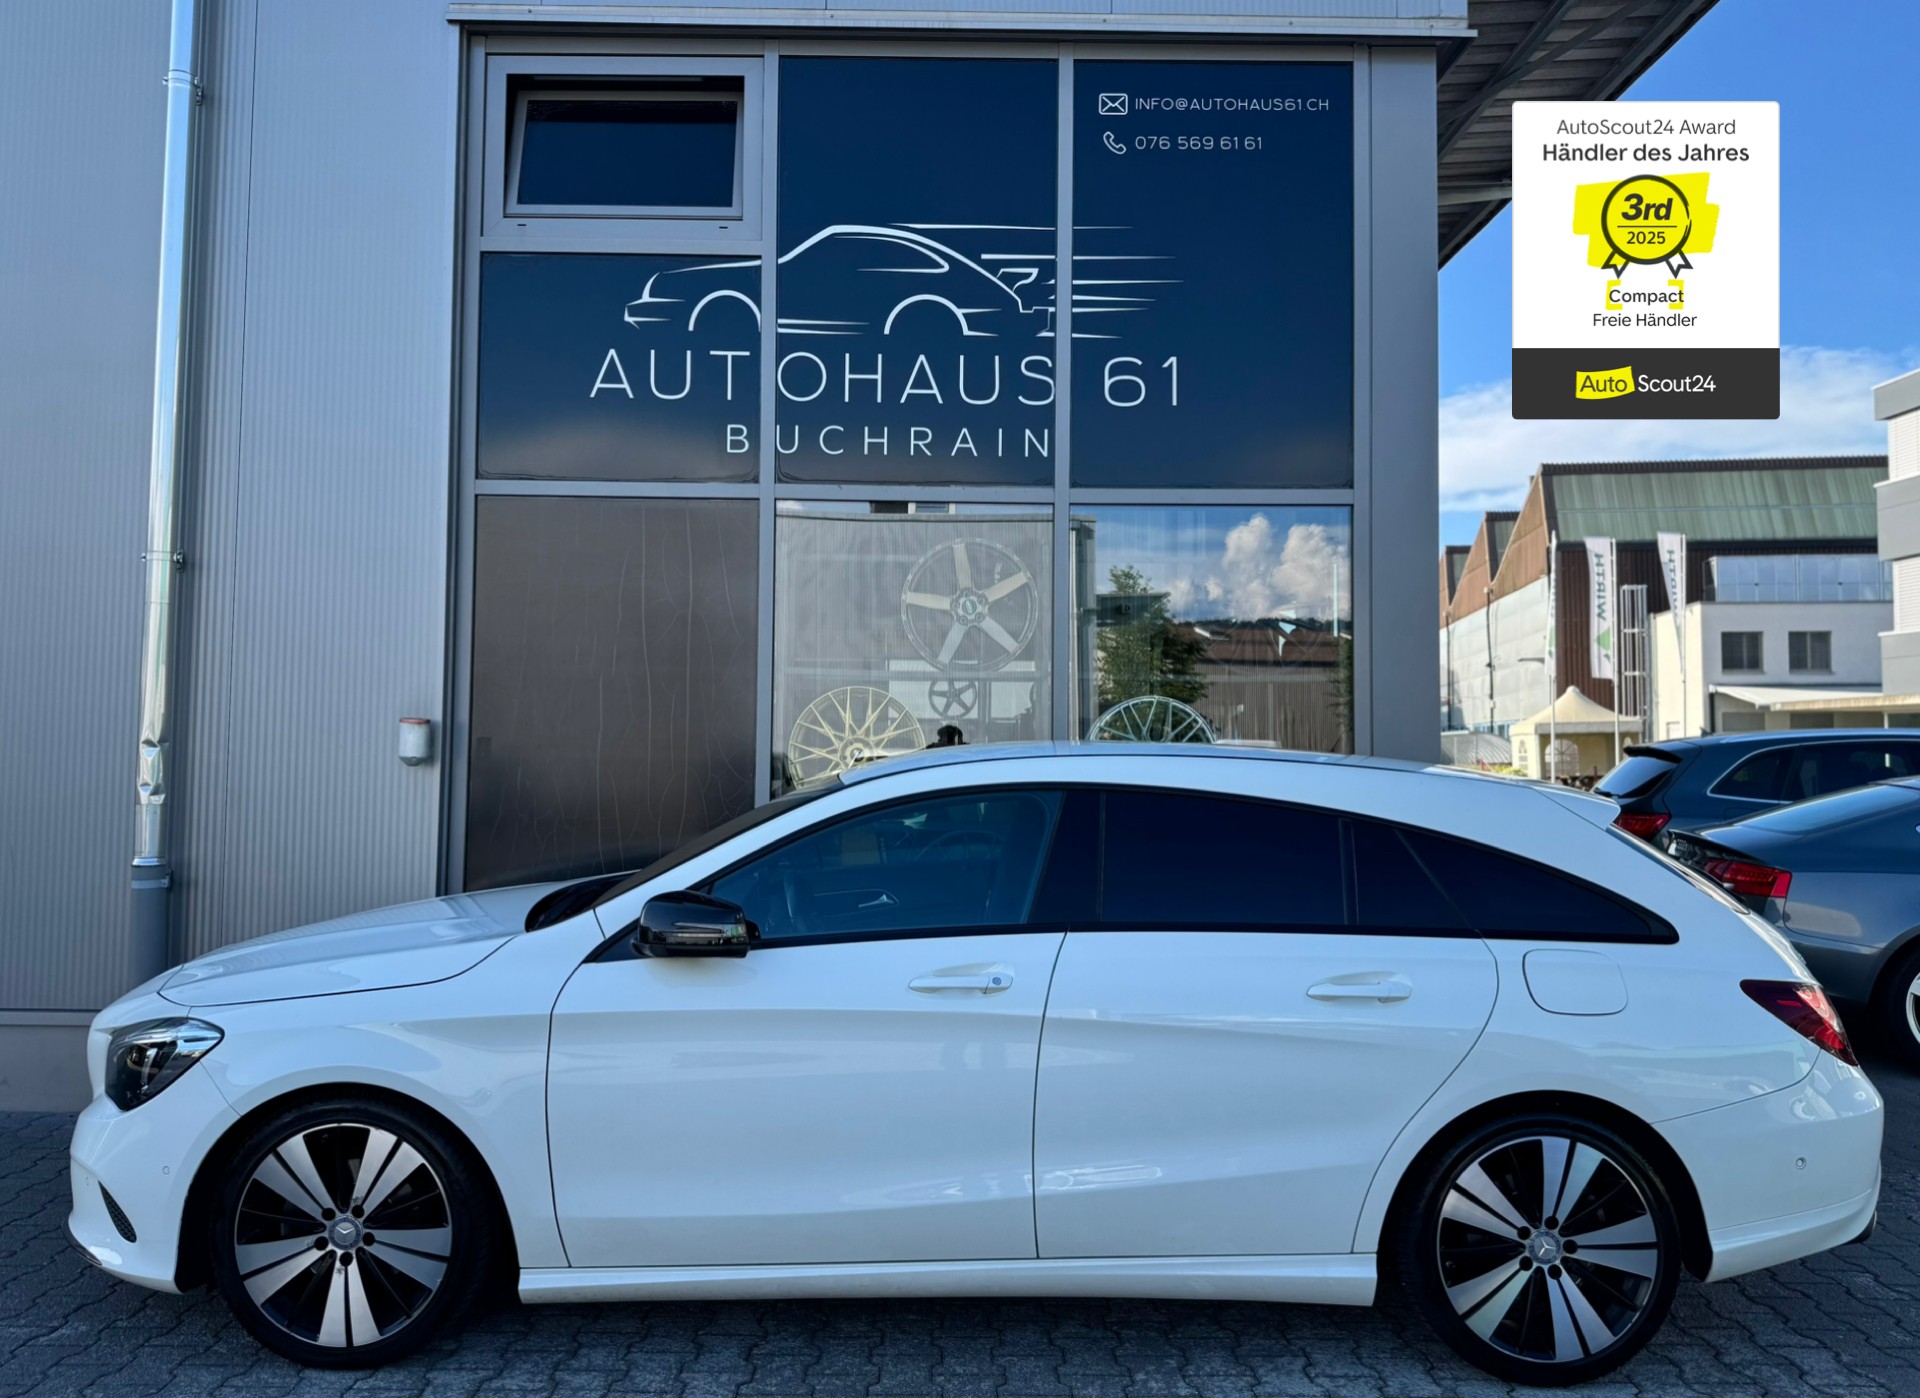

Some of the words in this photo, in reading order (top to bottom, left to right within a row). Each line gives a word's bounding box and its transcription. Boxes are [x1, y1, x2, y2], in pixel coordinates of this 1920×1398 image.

[1134, 97, 1330, 111] INFO@AUTOHAUS61.CH
[1134, 135, 1171, 150] 076
[1177, 135, 1214, 150] 569
[1220, 135, 1239, 150] 61
[1244, 135, 1262, 150] 61
[590, 349, 1056, 406] AUTOHAUS
[1104, 356, 1178, 407] 61
[726, 424, 1049, 458] BUCHRAIN
